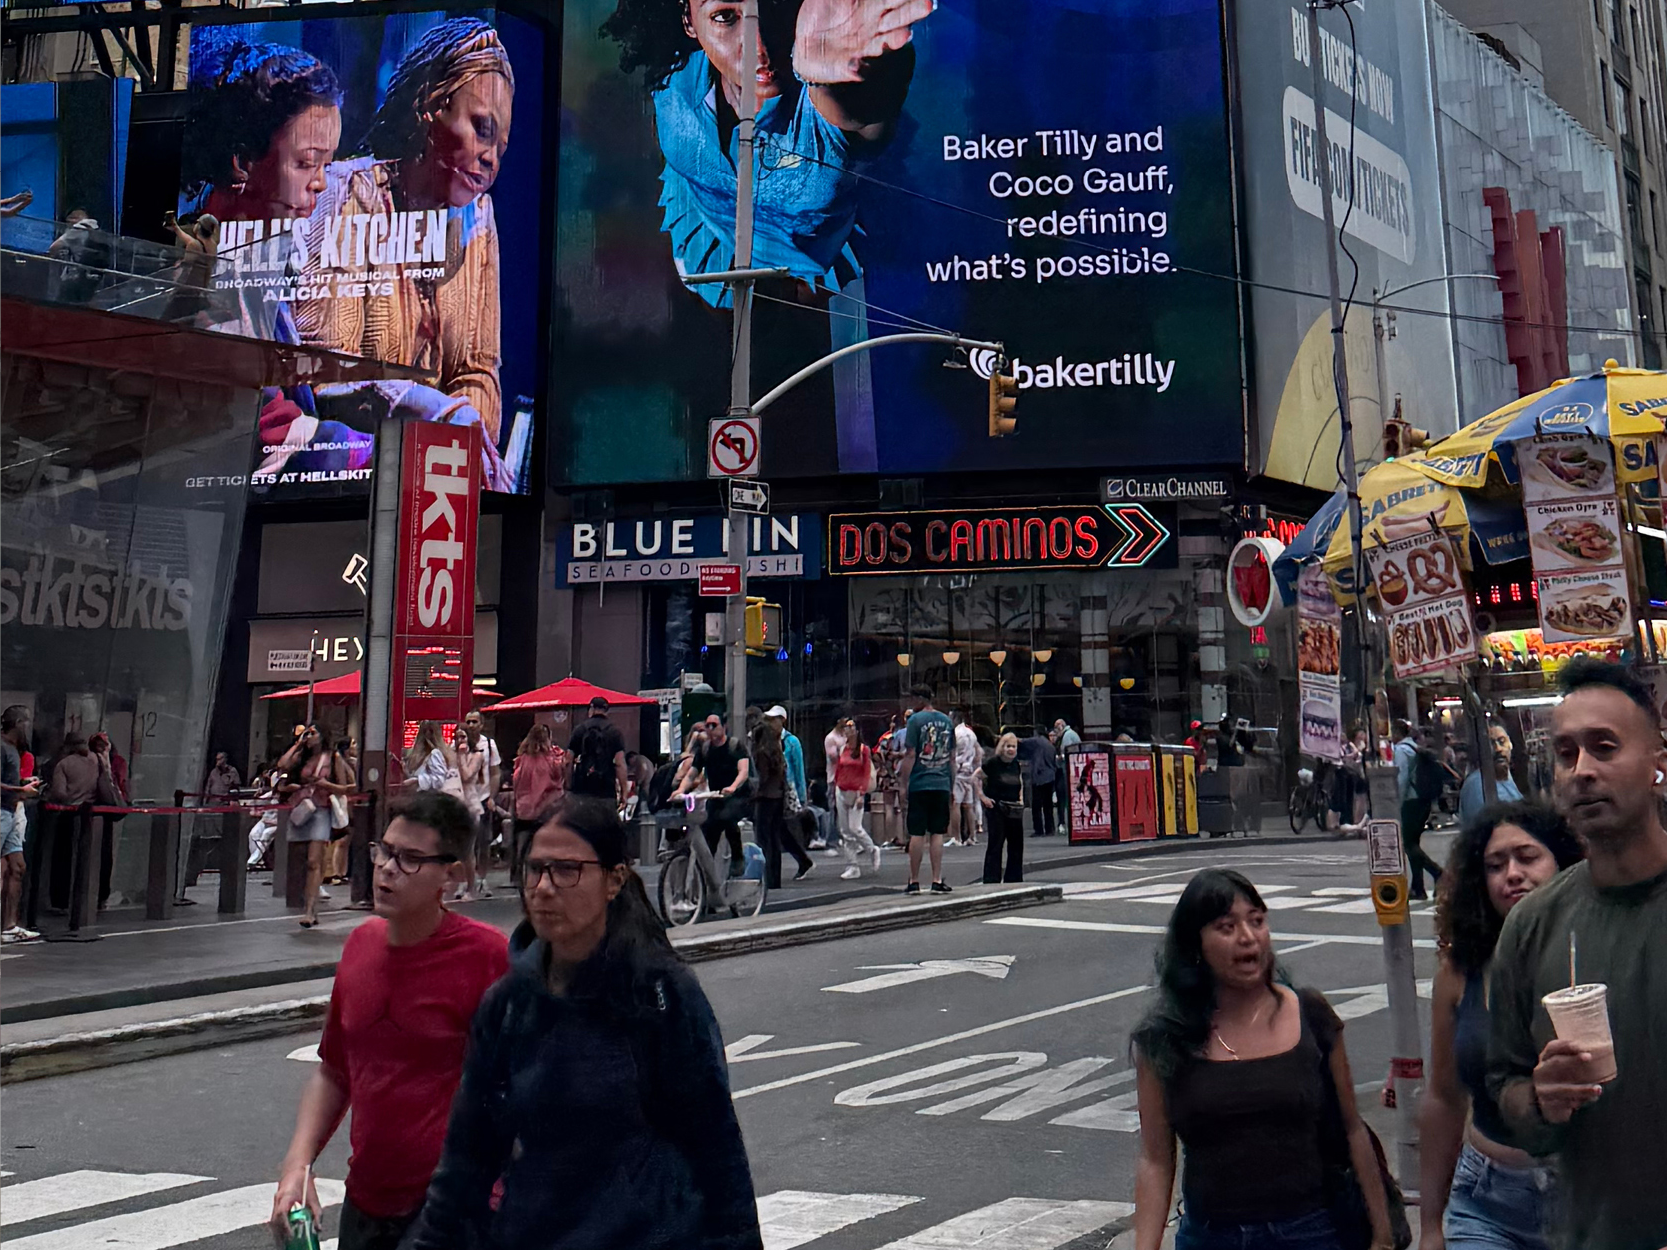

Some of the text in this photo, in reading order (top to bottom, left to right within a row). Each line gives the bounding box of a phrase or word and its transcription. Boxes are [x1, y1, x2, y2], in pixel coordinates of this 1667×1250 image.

[1291, 6, 1313, 69] BU
[942, 125, 1164, 161] Baker Tilly and
[989, 165, 1174, 198] Coco Gauff,
[1006, 207, 1168, 239] redefining
[215, 209, 449, 276] HELL'S KITCHEN
[310, 273, 335, 285] HIT
[336, 270, 401, 285] MUSICAL
[404, 267, 445, 280] FROM
[925, 247, 1178, 284] what's possible.
[263, 281, 395, 303] ALICIA KEYS
[1012, 353, 1176, 393] bakertilly
[262, 440, 373, 454] ORIGINAL BROADWAY
[185, 476, 216, 489] GET
[280, 472, 299, 484] AT
[417, 438, 470, 629] tkts
[572, 519, 695, 558] BLUE
[839, 515, 1099, 566] DOS CAMINOS
[572, 561, 691, 579] SEAFOOD
[140, 711, 158, 739] 12
